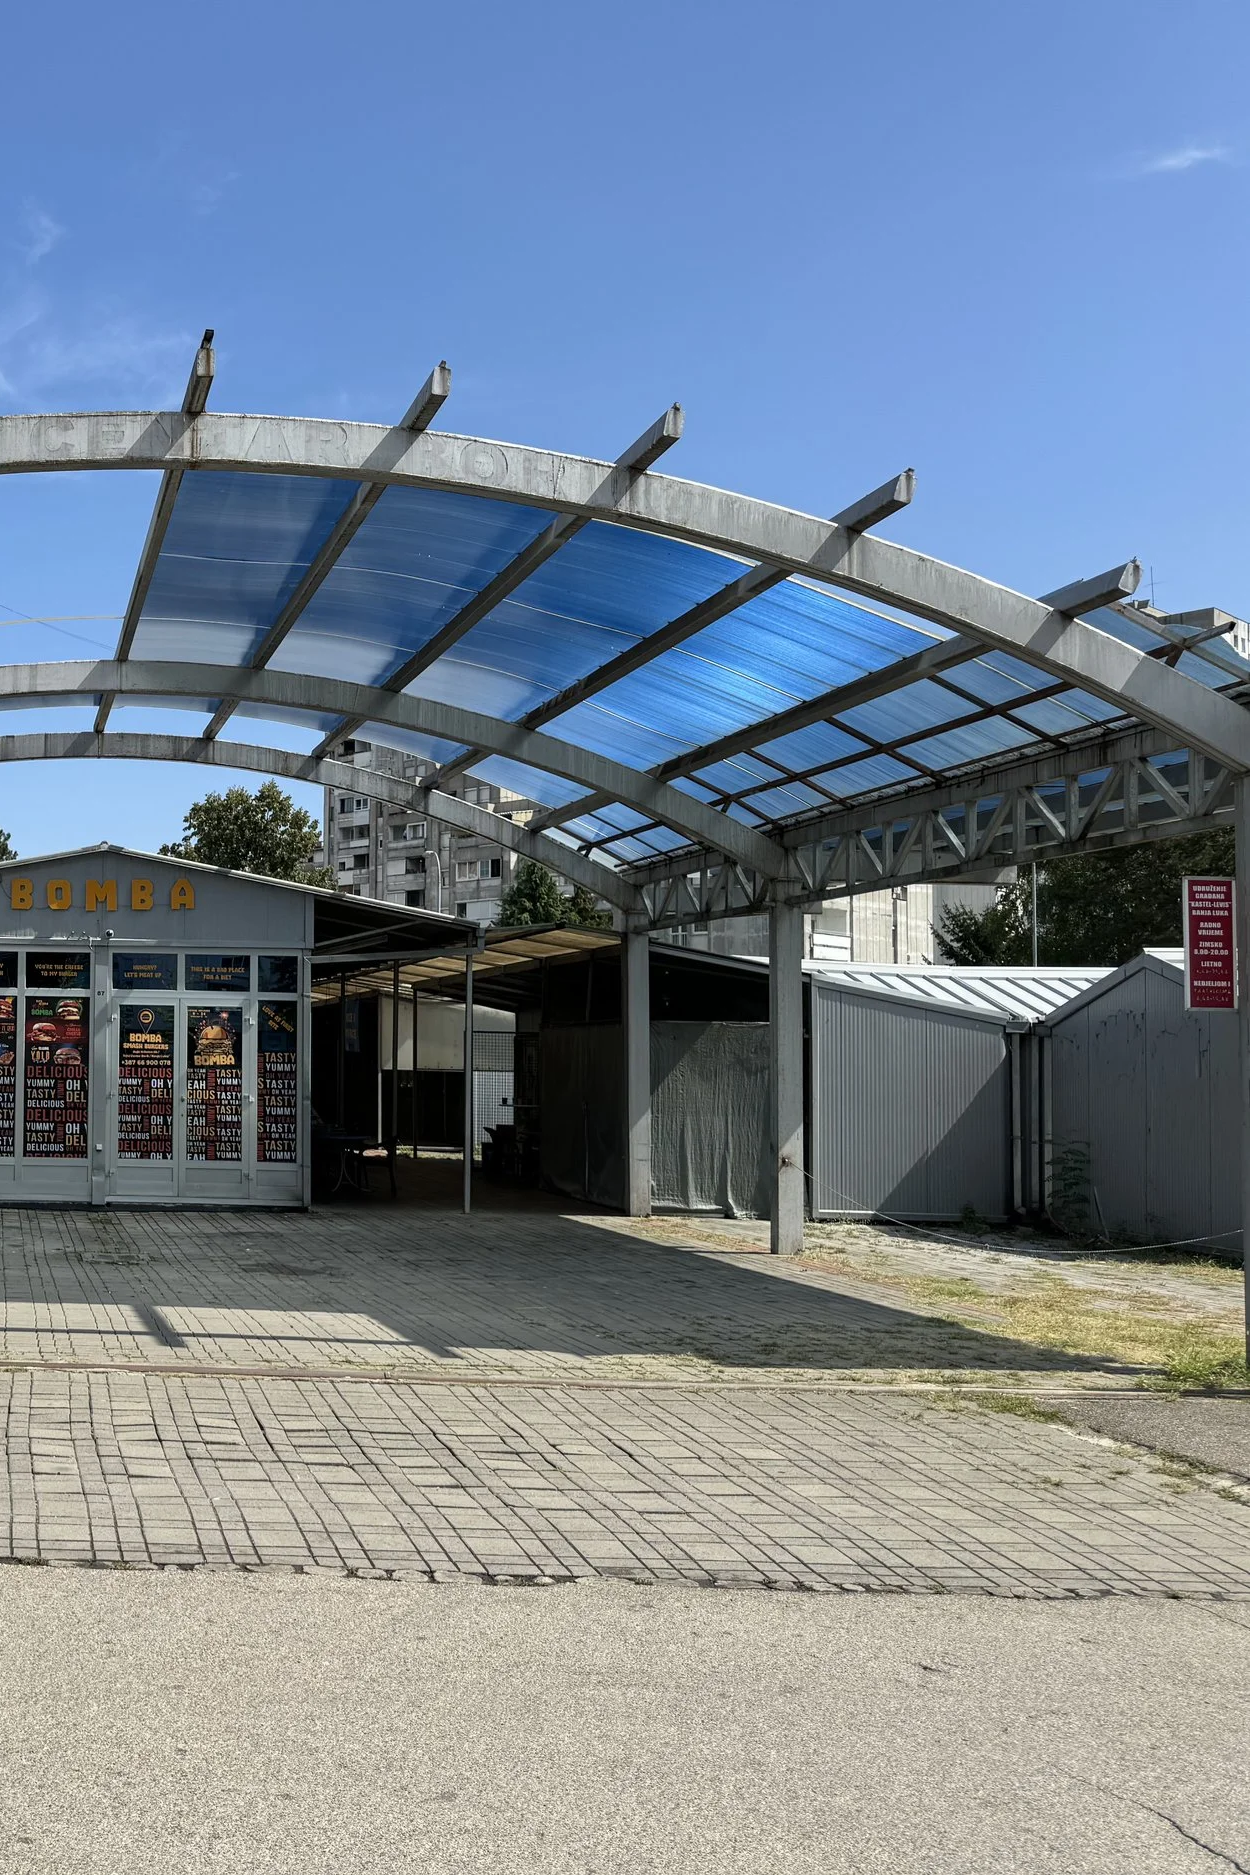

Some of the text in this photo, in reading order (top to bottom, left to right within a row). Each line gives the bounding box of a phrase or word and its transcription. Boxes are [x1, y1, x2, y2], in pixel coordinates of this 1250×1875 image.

[11, 878, 195, 912] BOMBA
[129, 1033, 162, 1043] BOMBA
[194, 1055, 235, 1066] BOMBA
[264, 1052, 296, 1063] TASTY
[265, 1063, 296, 1072] YUMMY
[119, 1068, 172, 1078] DELICIOUS
[216, 1069, 241, 1078] TASTY
[27, 1079, 55, 1087] YUMMY
[151, 1079, 163, 1088] OH
[188, 1080, 206, 1089] EAH
[266, 1080, 296, 1089] TASTY
[27, 1089, 56, 1099] TASTY
[119, 1086, 143, 1095] TASTY
[151, 1089, 172, 1098] DELI
[188, 1090, 215, 1099] CIOUS
[67, 1091, 86, 1102] DEL
[217, 1092, 241, 1100] TASTY
[27, 1100, 65, 1108] DELICIOUS
[264, 1096, 296, 1106] TASTY
[119, 1104, 172, 1114] DELICIOUS
[216, 1105, 241, 1114] TASTY
[265, 1107, 296, 1116] YUMMY
[151, 1116, 163, 1125] OH
[188, 1117, 206, 1126] EAH
[26, 1122, 55, 1131] YUMMY
[118, 1123, 142, 1131] TASTY
[151, 1125, 172, 1135] DELI
[266, 1123, 295, 1132] TASTY
[188, 1127, 215, 1136] CIOUS
[26, 1133, 55, 1142] TASTY
[66, 1135, 86, 1145] DEL
[27, 1143, 64, 1151] DELICIOUS
[119, 1141, 172, 1152] DELICIOUS
[216, 1142, 241, 1151] TASTY
[264, 1140, 296, 1150] TASTY
[265, 1151, 296, 1160] YUMMY
